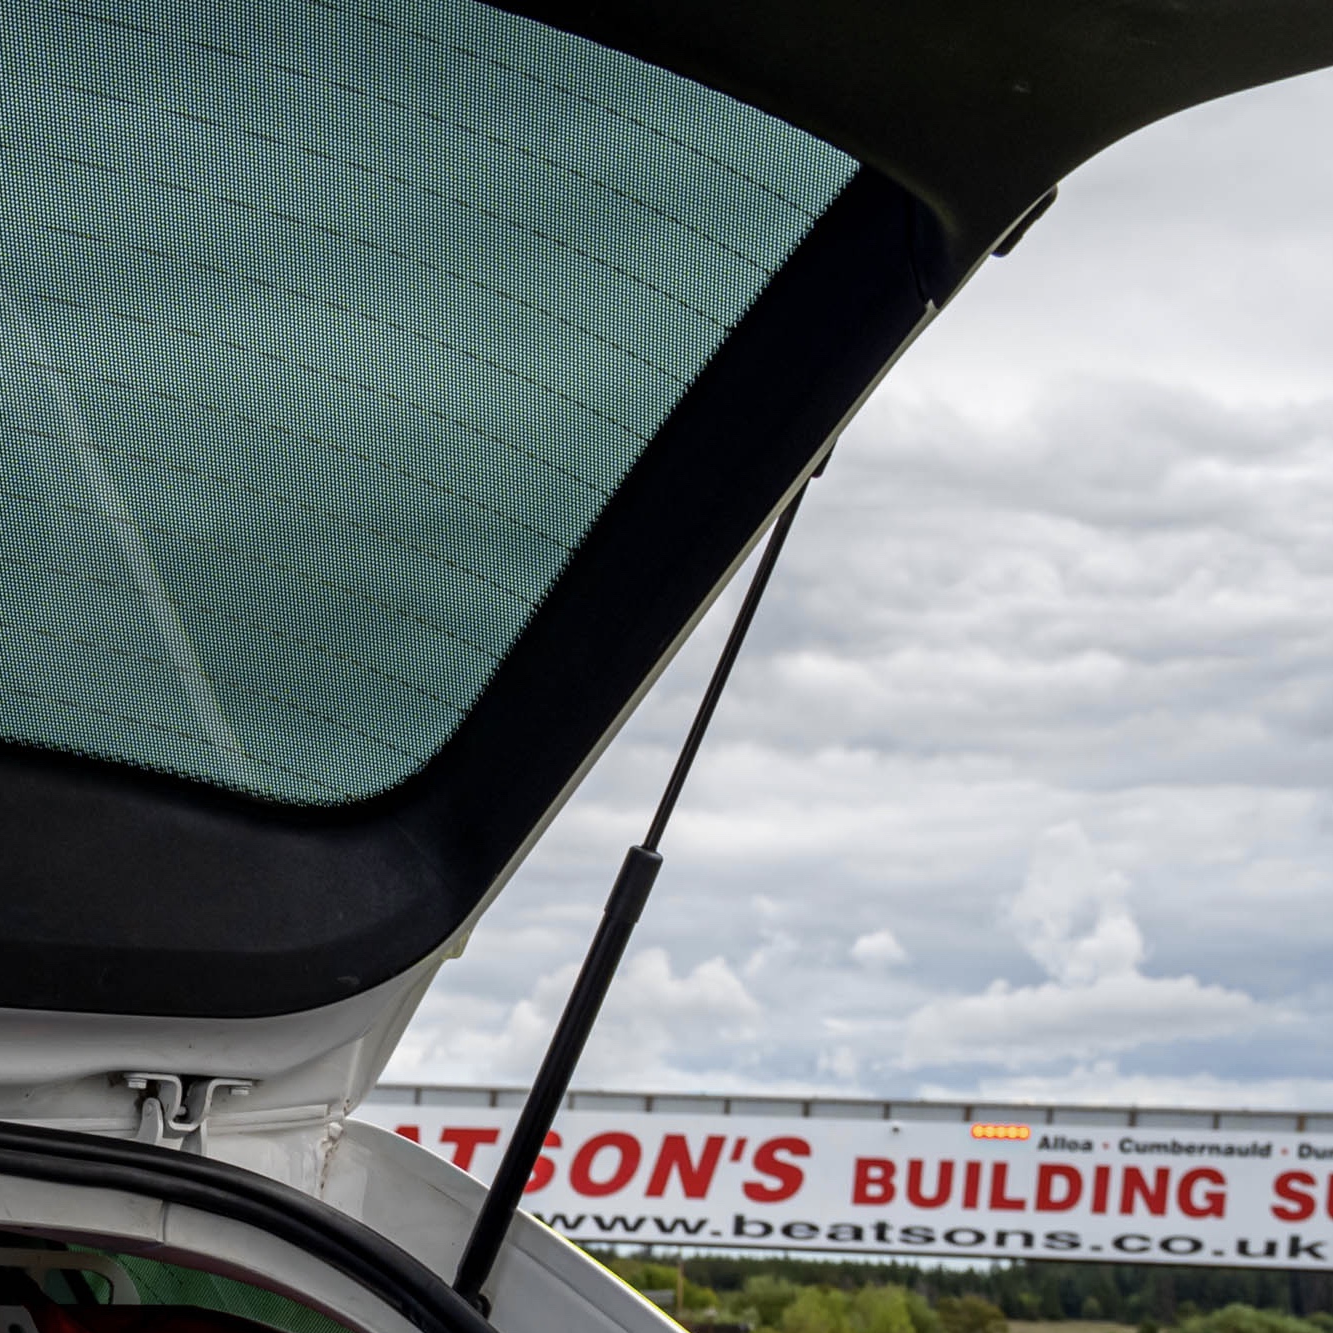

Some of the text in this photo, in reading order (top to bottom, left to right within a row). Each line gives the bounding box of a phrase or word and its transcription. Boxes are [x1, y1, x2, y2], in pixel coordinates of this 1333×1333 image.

[1038, 1135, 1094, 1152] Alloa
[1118, 1137, 1273, 1158] Cumbernauld
[852, 1157, 1227, 1219] BUILDING
[1271, 1170, 1333, 1222] S
[534, 1213, 1327, 1261] www.beatsons.co.uk
